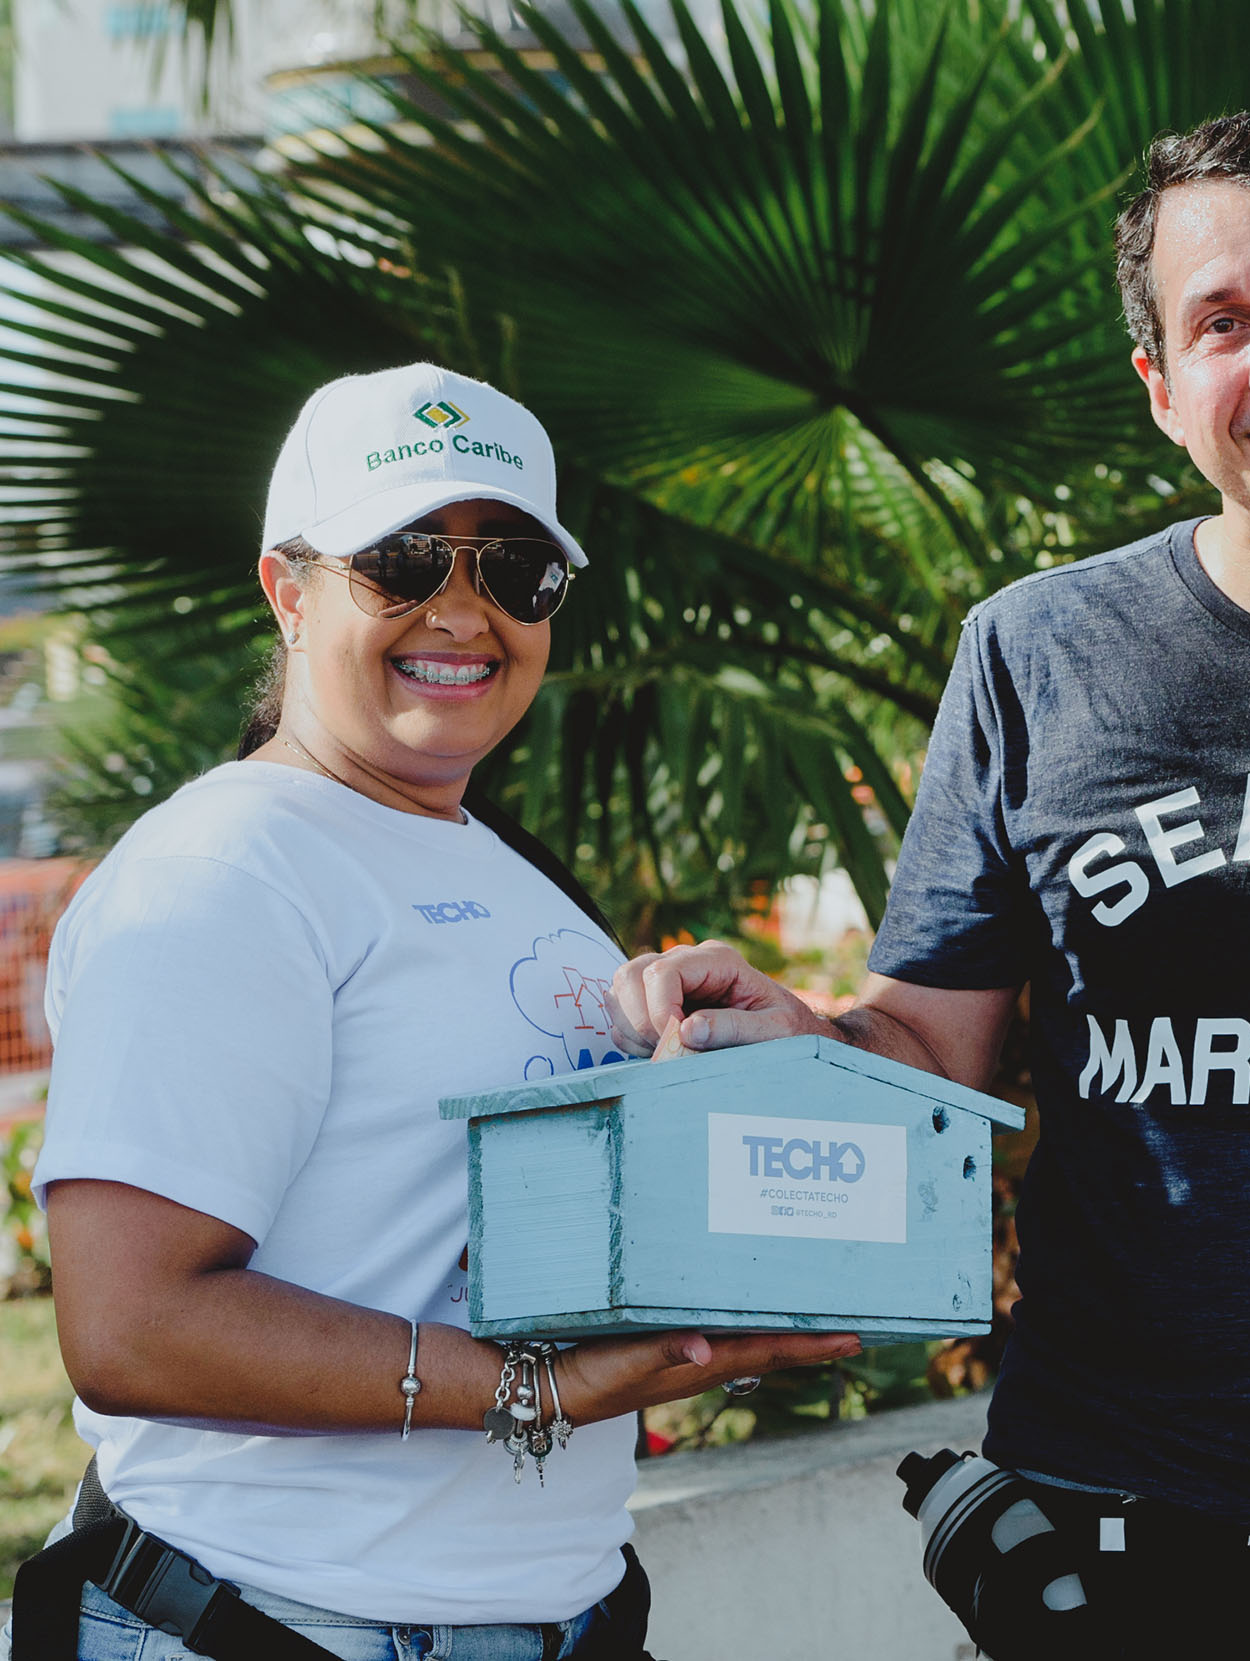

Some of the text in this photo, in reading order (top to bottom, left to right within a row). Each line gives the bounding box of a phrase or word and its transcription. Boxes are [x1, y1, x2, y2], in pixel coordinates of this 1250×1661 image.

[367, 434, 523, 472] Banco Caribe
[412, 901, 491, 924] TECHO
[742, 1135, 866, 1184] TECHO
[760, 1188, 849, 1204] #COLECTATECHO
